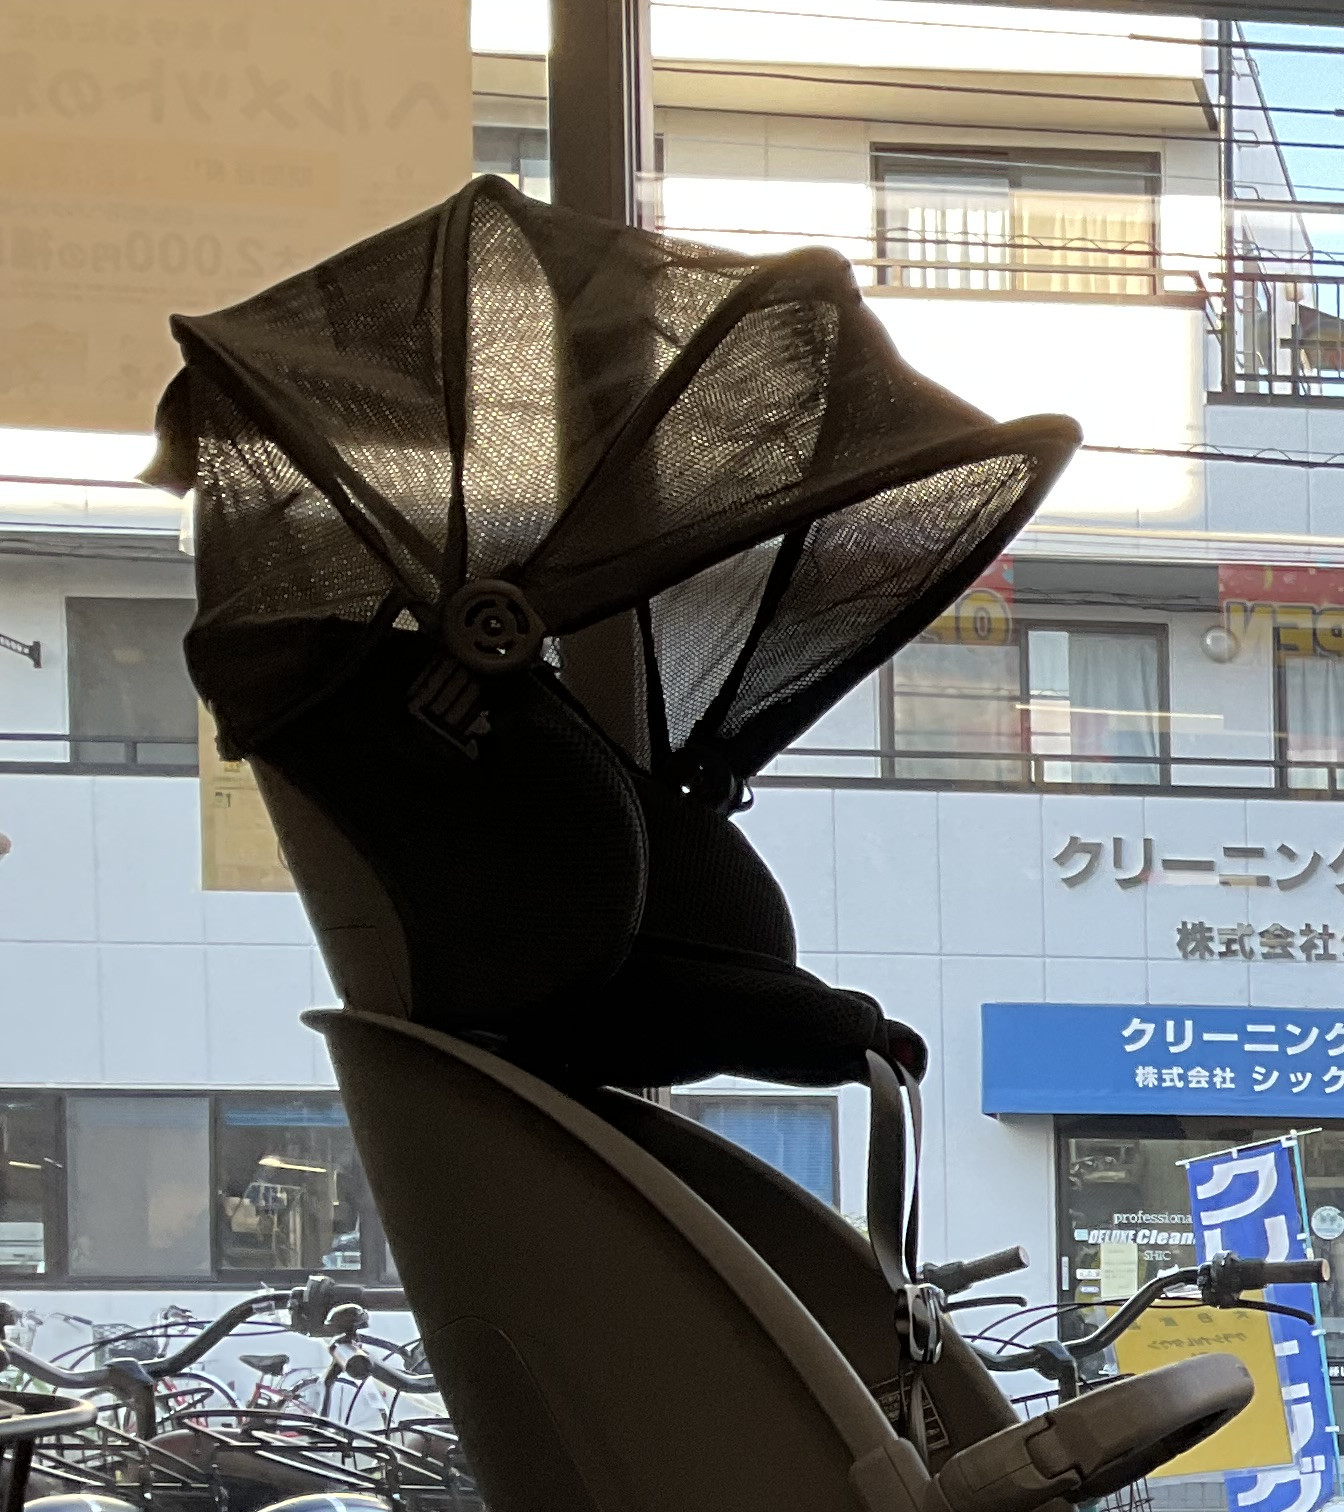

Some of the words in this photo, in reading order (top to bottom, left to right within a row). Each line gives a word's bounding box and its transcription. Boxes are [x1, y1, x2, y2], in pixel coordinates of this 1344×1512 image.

[1134, 1065, 1236, 1091] 株式会社
[1113, 1210, 1193, 1226] professiona
[1088, 1230, 1137, 1244] DELUXE
[1136, 1229, 1196, 1245] Clean
